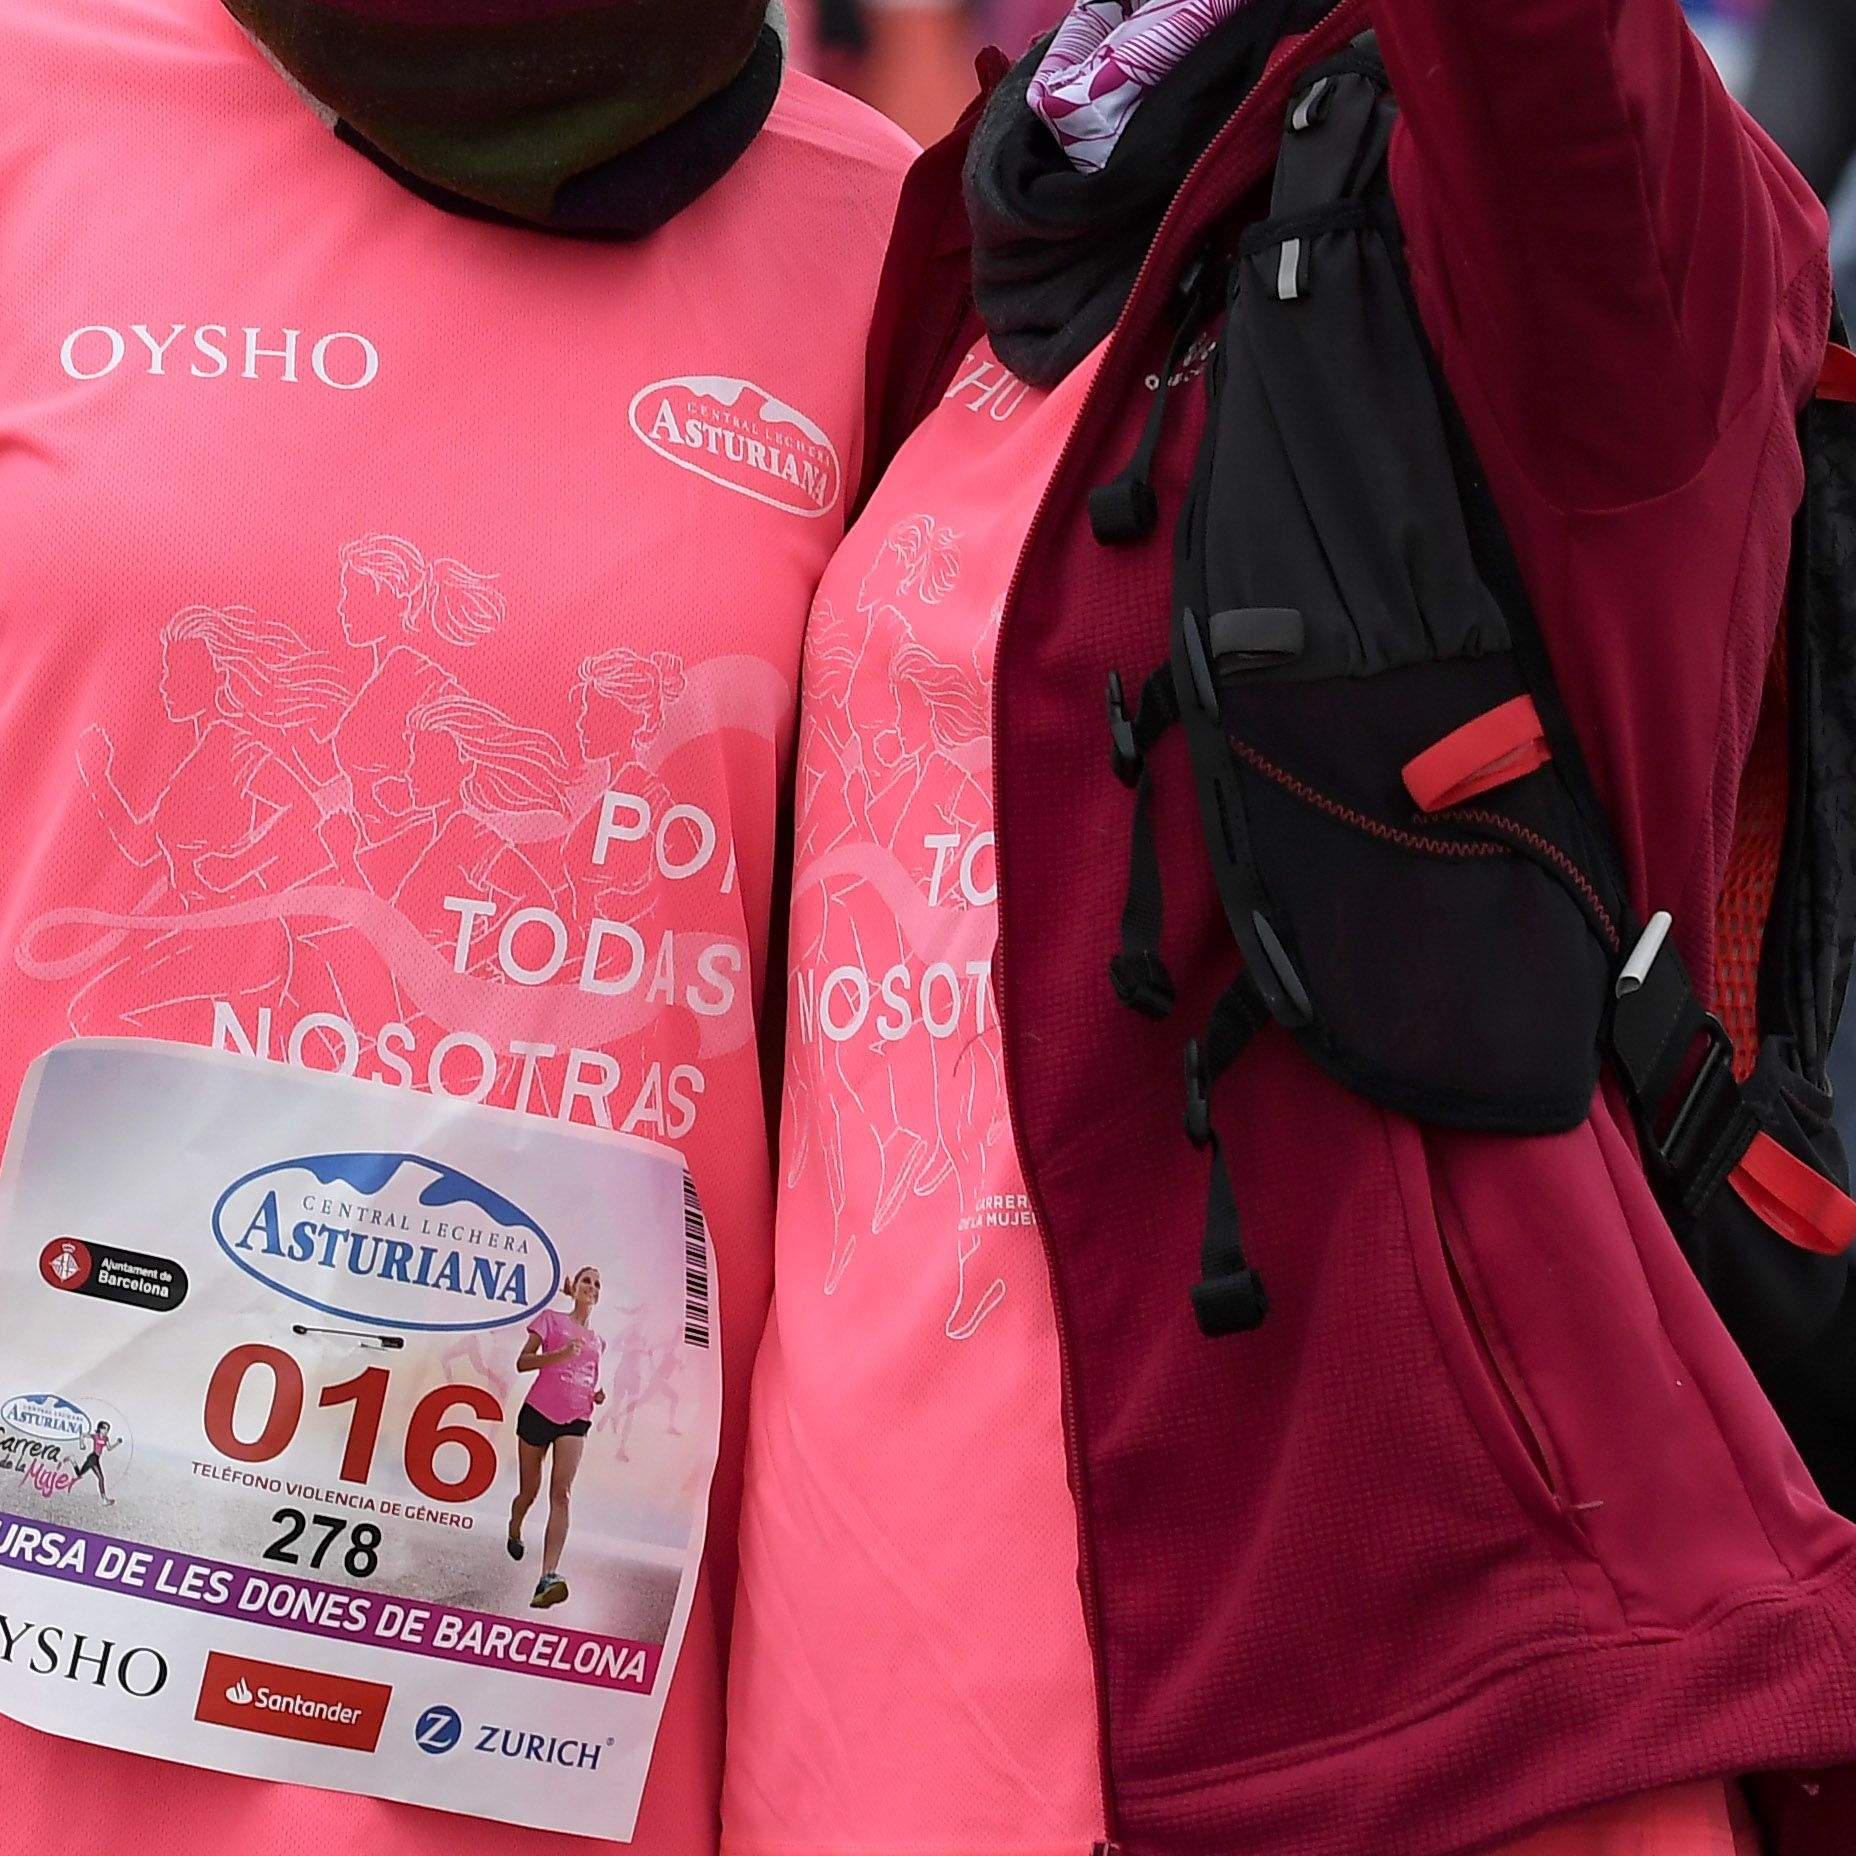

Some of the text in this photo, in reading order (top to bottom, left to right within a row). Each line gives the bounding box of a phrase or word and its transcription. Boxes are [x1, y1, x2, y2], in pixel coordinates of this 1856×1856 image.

[60, 324, 379, 389] OYSHO
[649, 398, 828, 507] ASTURIANA
[688, 402, 831, 466] CENTRAL LECHERA
[591, 790, 736, 894] PO
[924, 831, 997, 907] TO
[442, 895, 741, 1016] TODAS
[797, 961, 992, 1044] NOSOT
[211, 1000, 705, 1140] NOSOTRAS
[235, 1190, 529, 1306] ASTURIANA
[303, 1195, 529, 1255] CENTRAL LECHERA
[98, 1269, 169, 1298] Barcelona
[101, 1257, 172, 1283] Ajuntament de
[6, 1403, 83, 1436] ASTURIANA
[203, 1343, 504, 1503] 016
[19, 1458, 82, 1498] Mujer
[192, 1460, 474, 1530] TELÉFONO VIOLENCIA DE GÉNERO
[262, 1507, 382, 1578] 278
[95, 1545, 153, 1587] DE
[154, 1558, 234, 1604] LES
[237, 1577, 370, 1632] DONES
[374, 1604, 431, 1643] DE
[432, 1615, 647, 1685] BARCELONA
[254, 1686, 363, 1725] Santander
